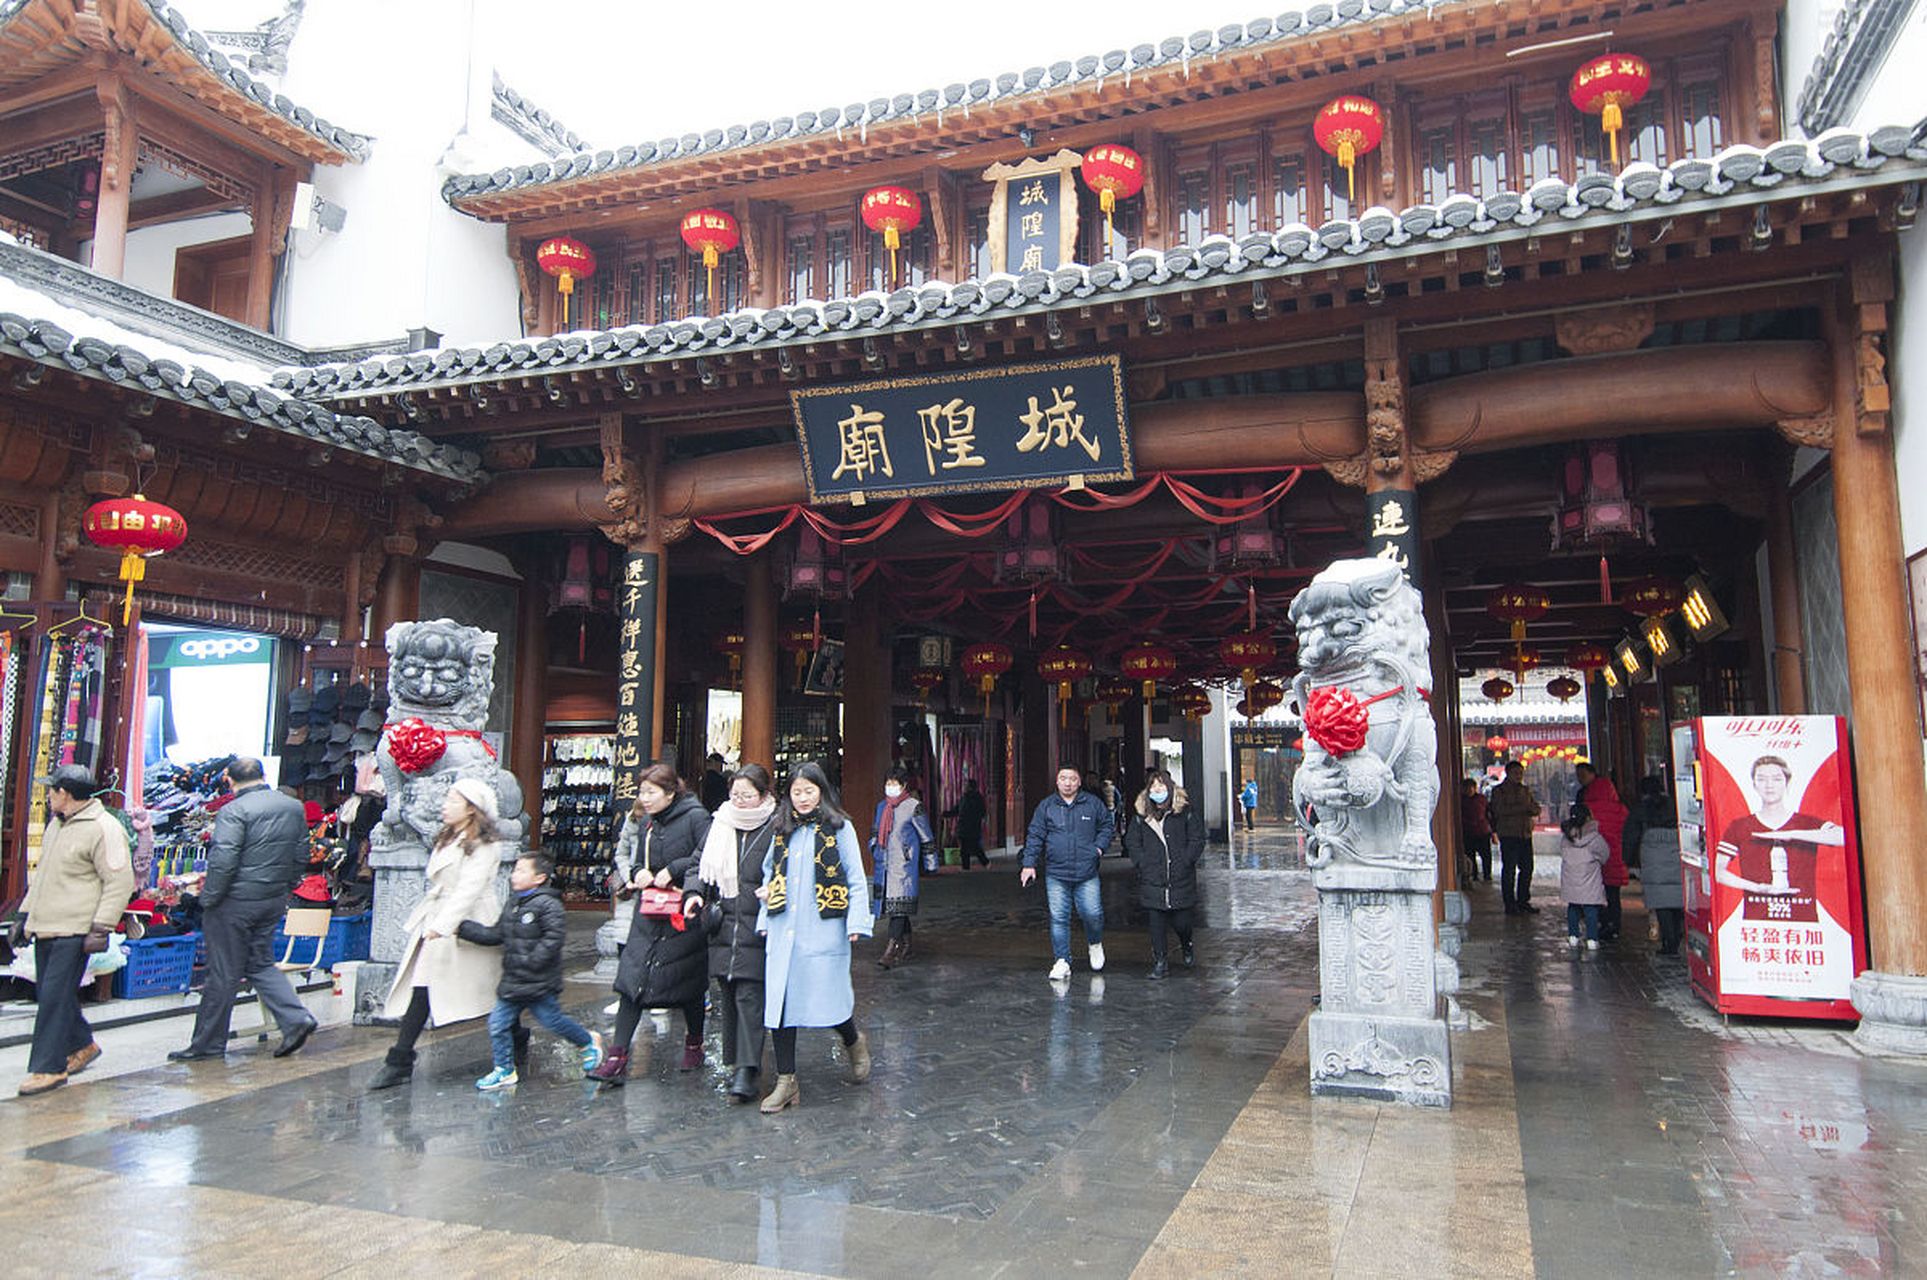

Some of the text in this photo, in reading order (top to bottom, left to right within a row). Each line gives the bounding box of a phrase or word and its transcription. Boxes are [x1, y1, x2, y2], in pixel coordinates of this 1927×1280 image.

[1019, 180, 1048, 272] 城隍廟
[1741, 926, 1823, 945] 轻盈有加
[1742, 947, 1825, 966] 畅爽依旧
